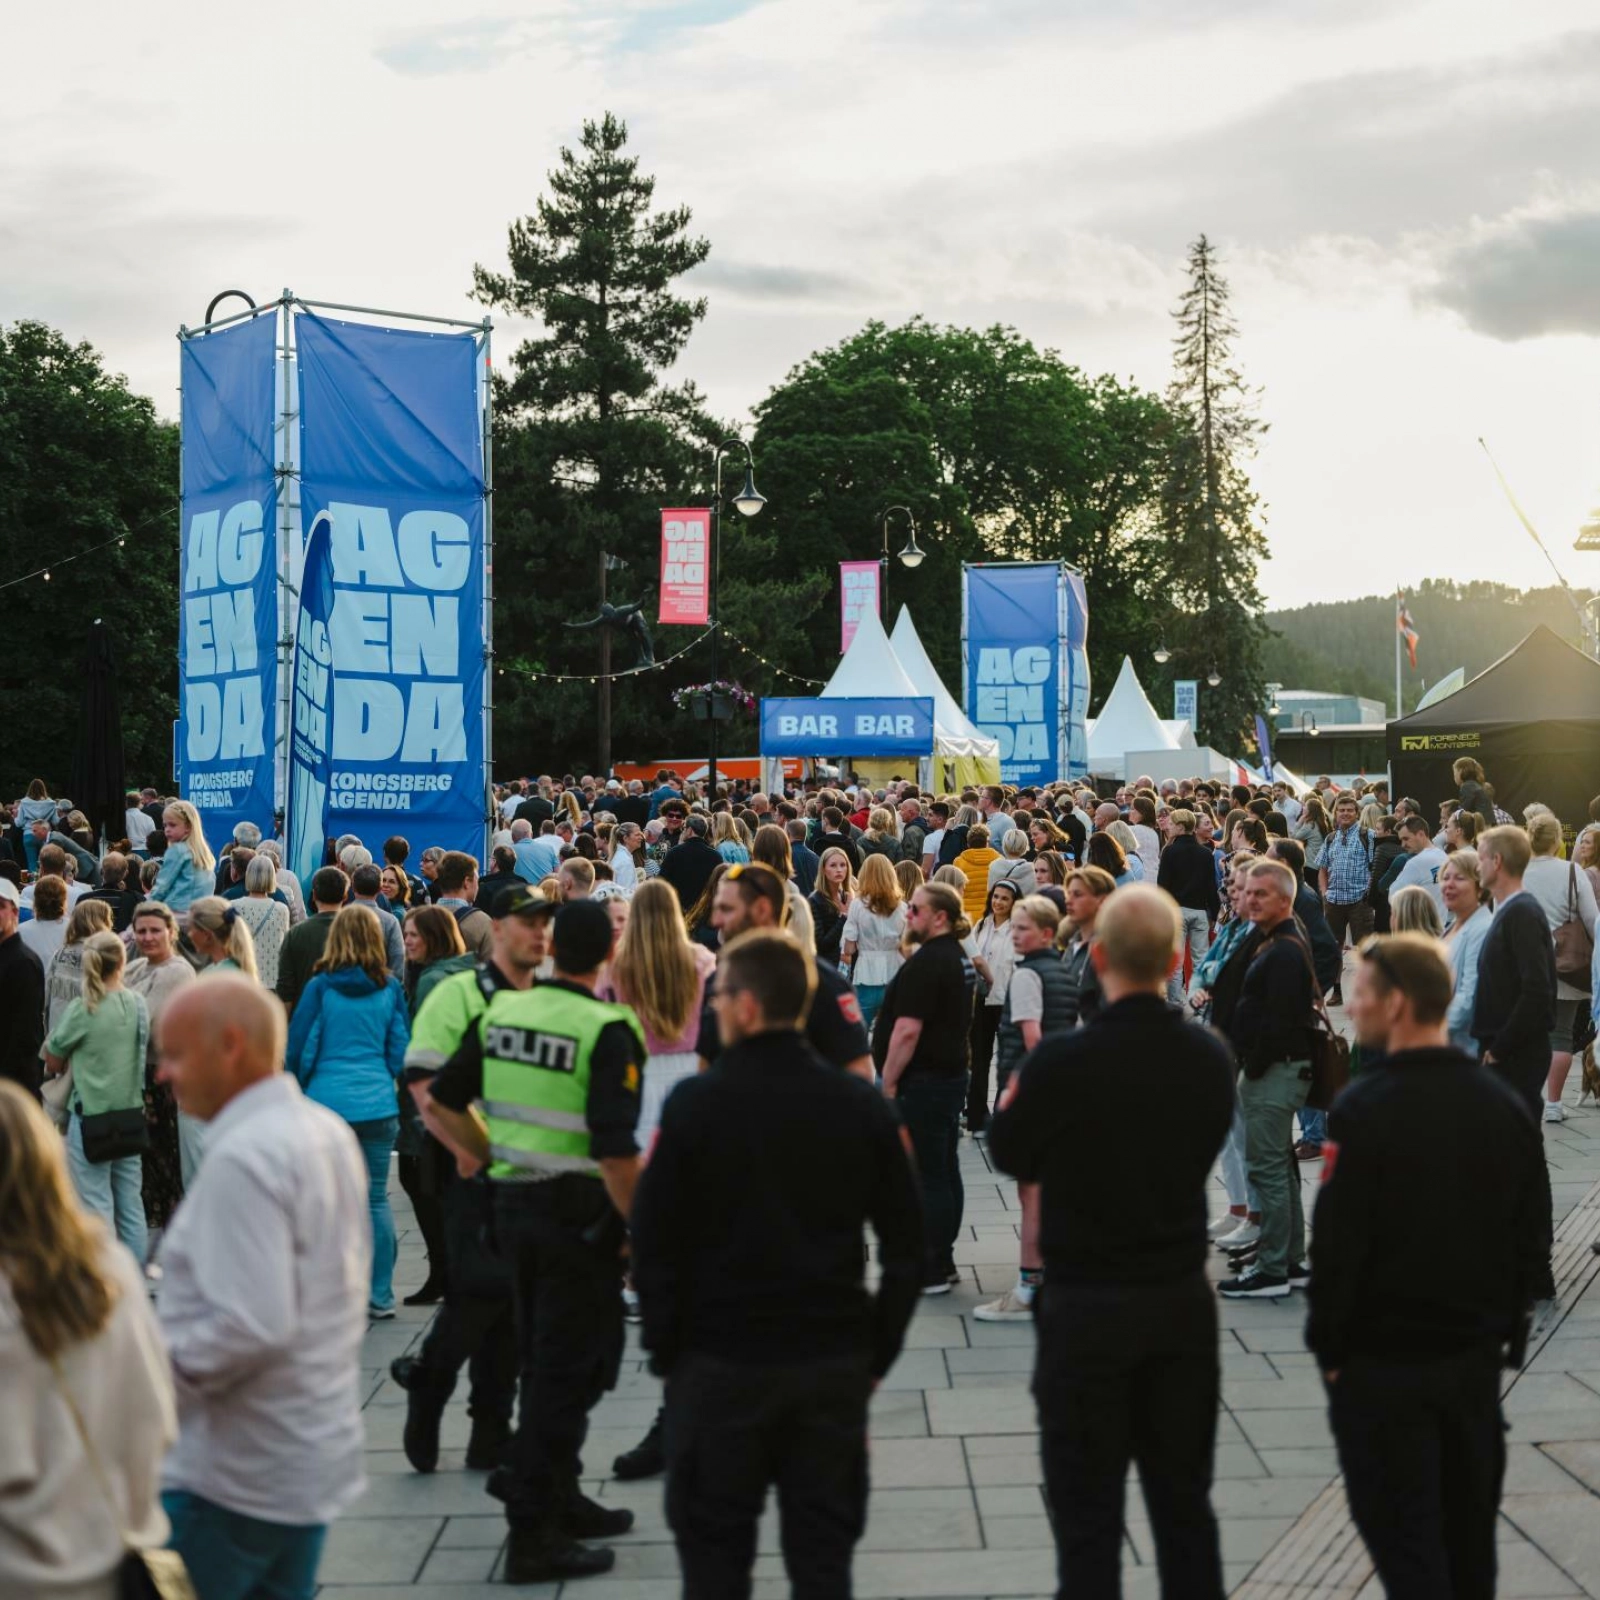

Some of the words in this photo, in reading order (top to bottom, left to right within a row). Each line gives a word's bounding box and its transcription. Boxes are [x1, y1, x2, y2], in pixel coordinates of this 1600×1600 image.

[185, 500, 264, 592] AG
[327, 501, 471, 591] AG
[185, 588, 258, 677] EN
[327, 589, 460, 676] EN
[976, 646, 1051, 685] AG
[185, 675, 265, 762] DA
[332, 678, 468, 762] DA
[778, 715, 838, 738] BAR
[855, 715, 915, 738] BAR
[976, 685, 1044, 722] EN
[189, 769, 253, 790] KONGSBERG
